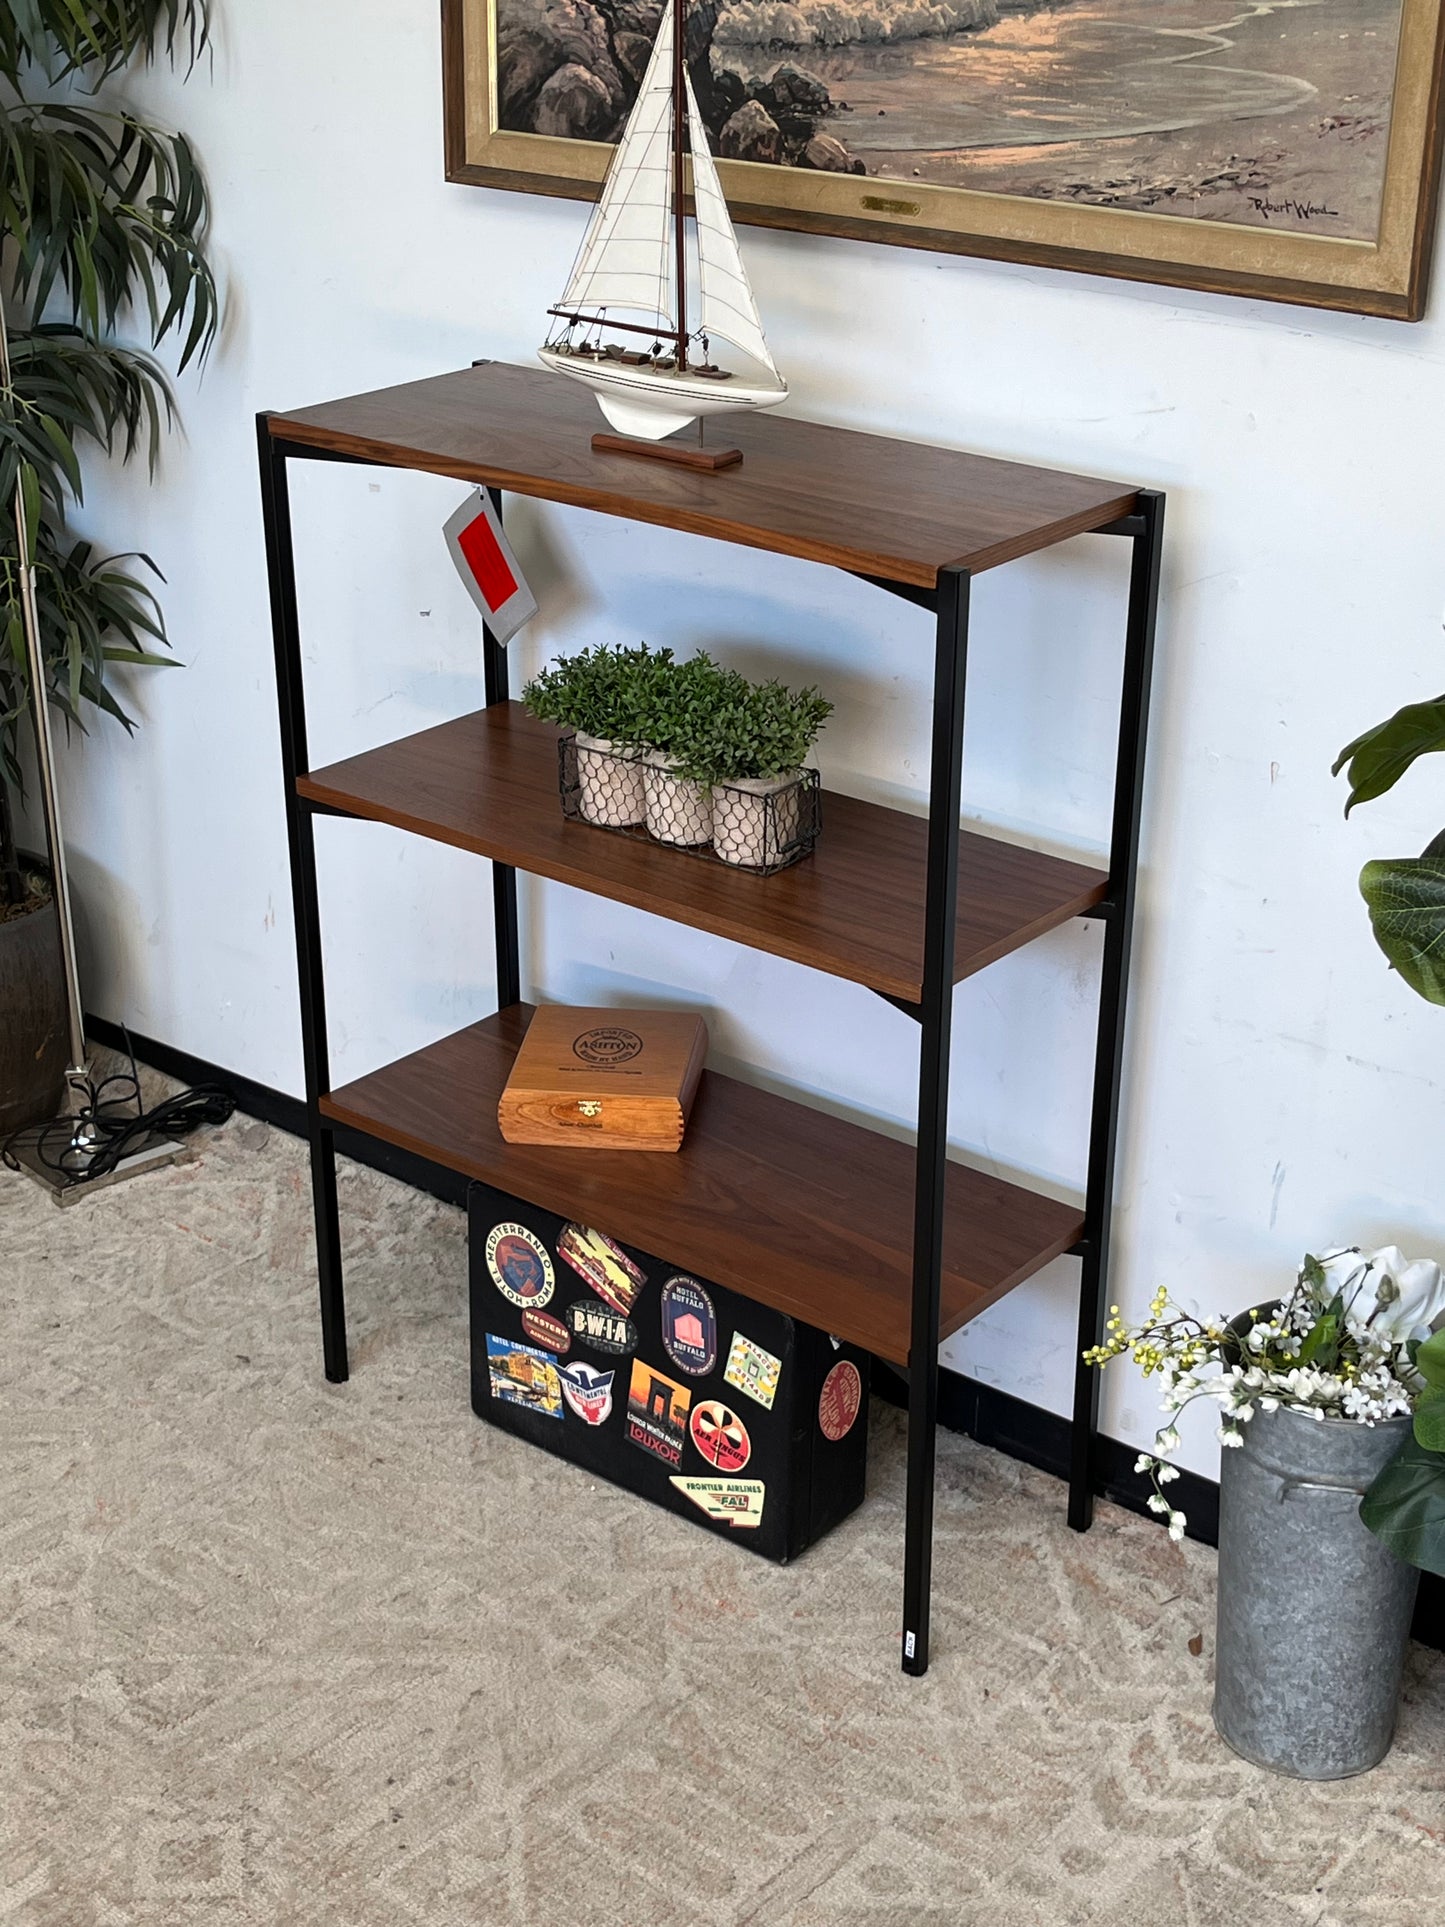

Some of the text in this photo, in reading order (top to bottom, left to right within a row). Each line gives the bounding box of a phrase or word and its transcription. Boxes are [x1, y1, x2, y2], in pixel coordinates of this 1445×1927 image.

[1247, 197, 1339, 219] Robert Wood
[579, 1040, 638, 1050] ASHTON
[487, 1224, 552, 1308] HOTEL MEDITERRANEO ROMA
[672, 1292, 704, 1310] BUFFALO
[677, 1286, 699, 1301] HOTEL
[525, 1311, 568, 1338] WESTERN
[529, 1329, 561, 1349] AIRLINES
[674, 1341, 706, 1359] BUFFALO
[742, 1339, 772, 1370] PALACE
[566, 1381, 607, 1399] CONTINENTAL
[735, 1367, 765, 1400] GSTAAD
[629, 1422, 681, 1465] LOUXOR
[694, 1428, 746, 1463] AER LINGUS
[686, 1483, 761, 1494] FRONTIER AIRLINES
[721, 1496, 744, 1506] FAL
